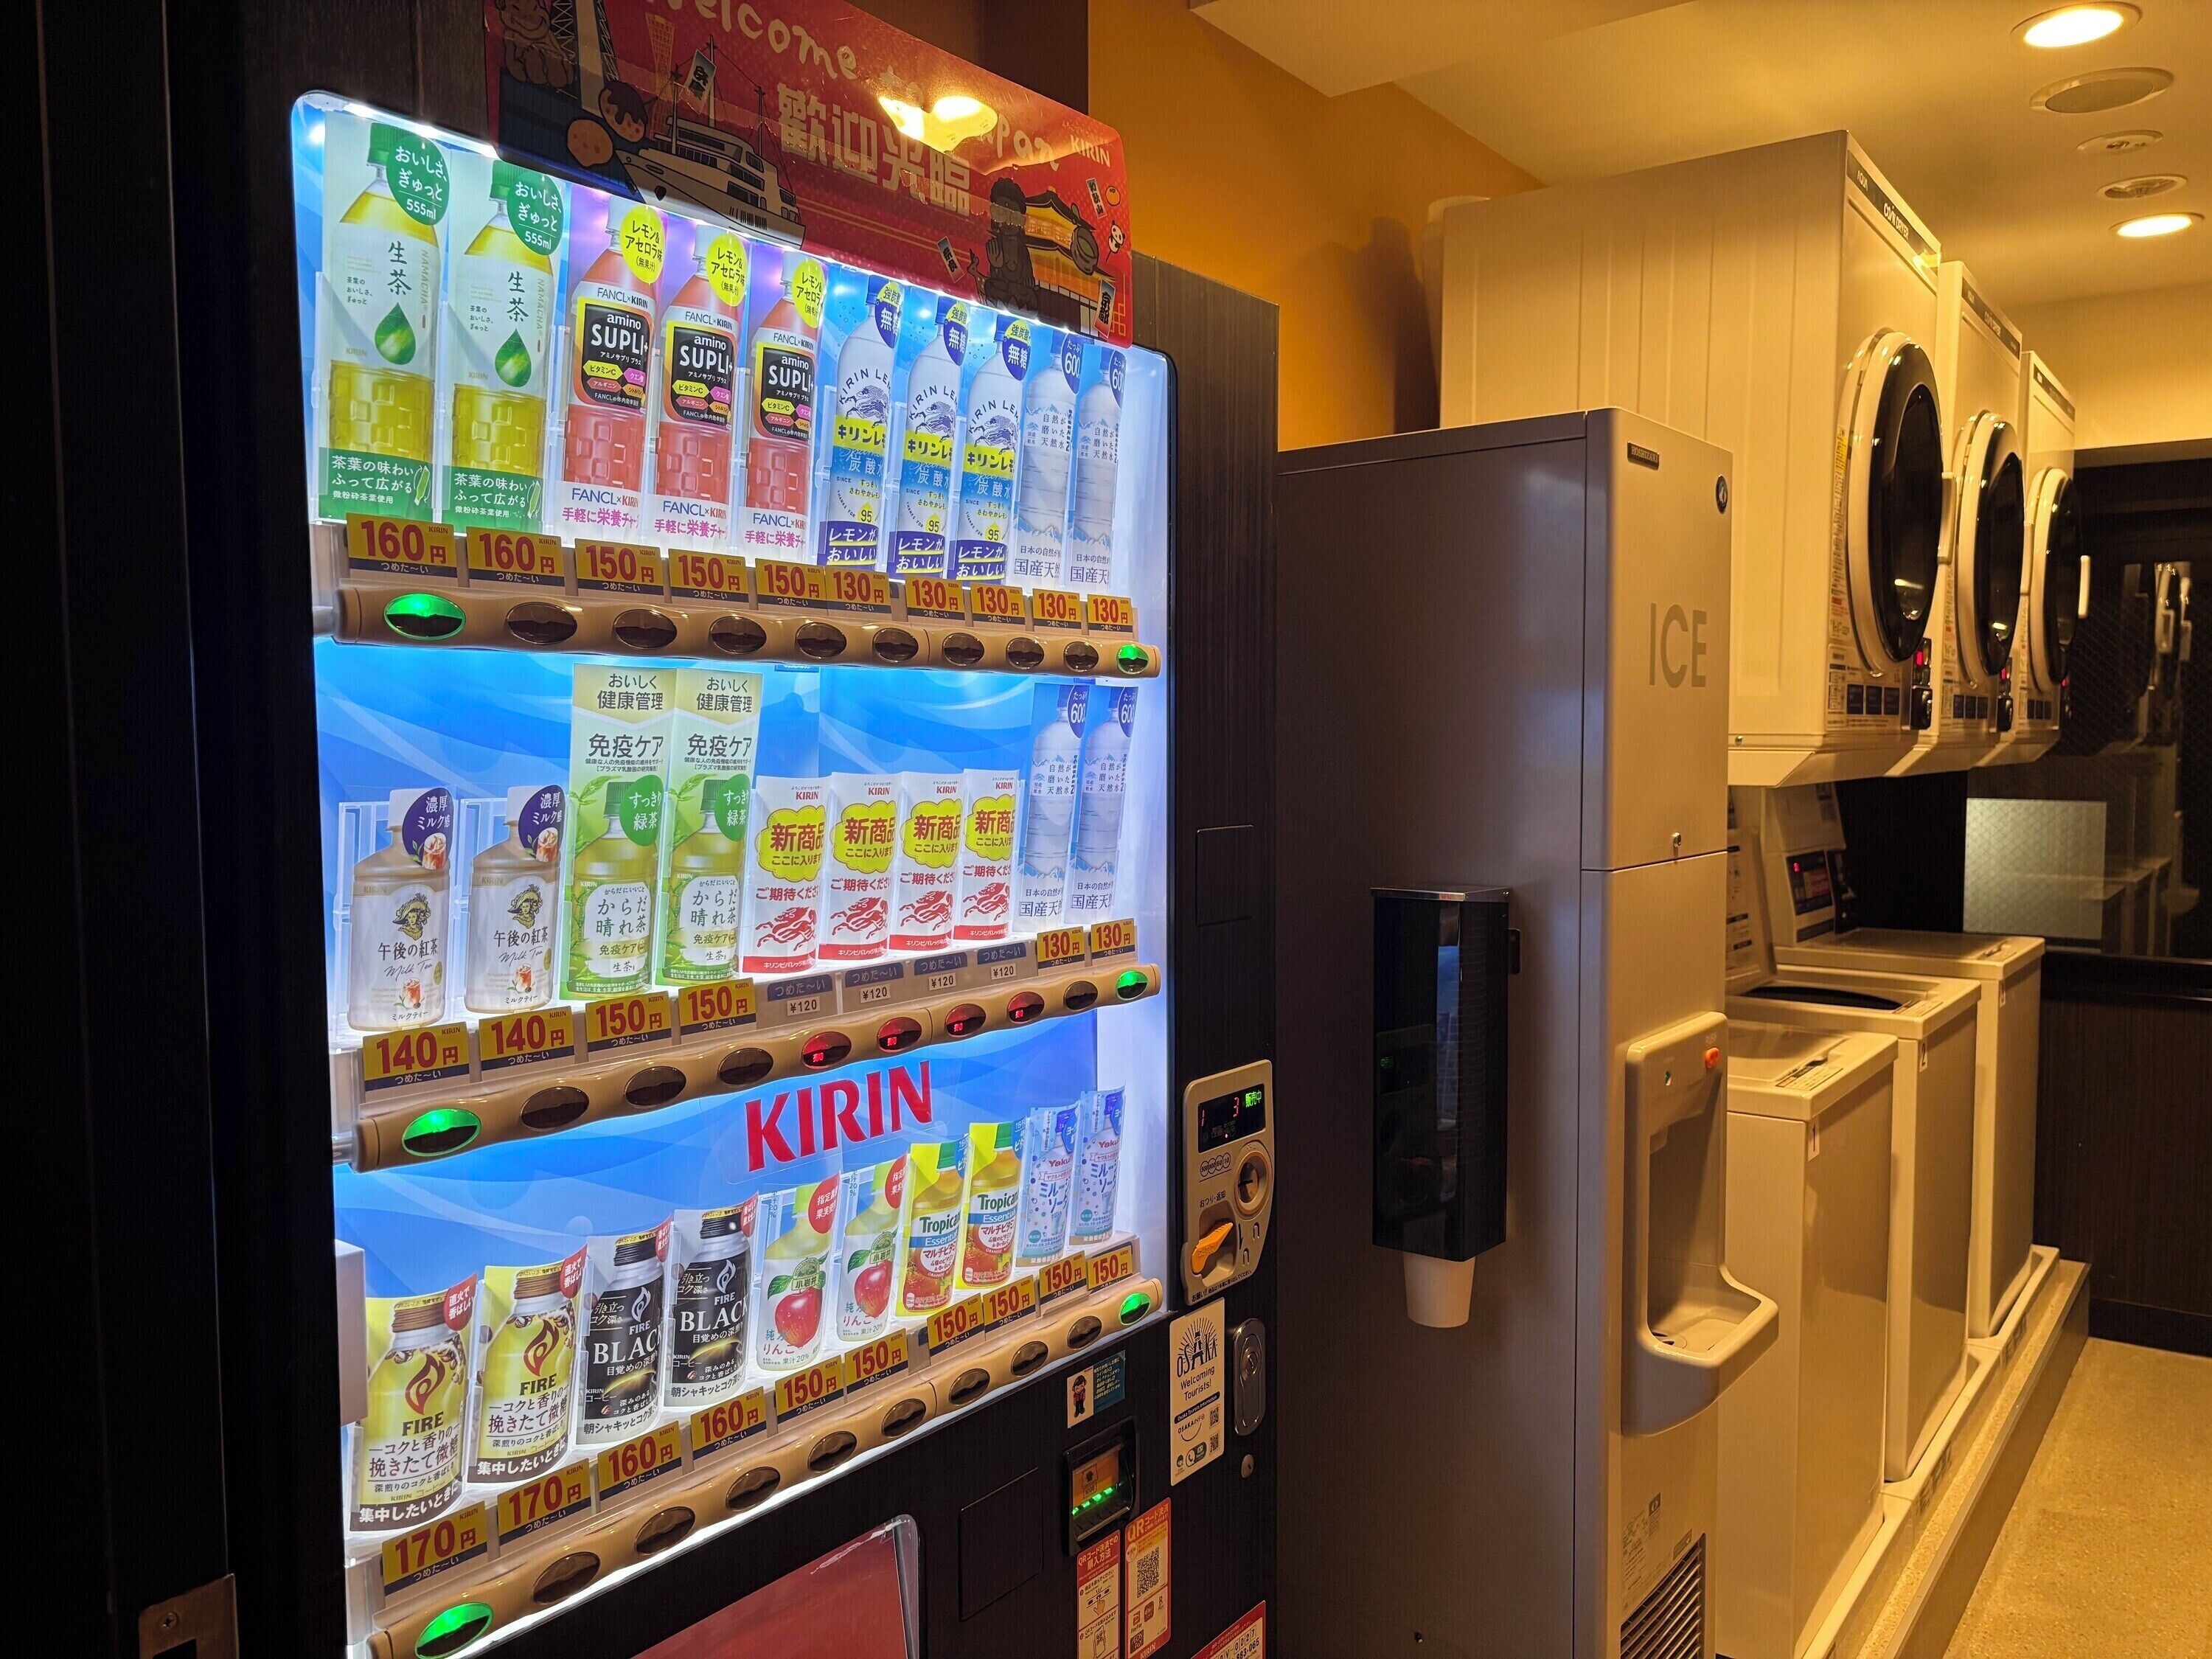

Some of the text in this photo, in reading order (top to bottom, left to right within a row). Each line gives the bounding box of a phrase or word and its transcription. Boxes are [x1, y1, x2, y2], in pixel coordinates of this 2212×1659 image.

[1071, 135, 1111, 168] KIRIN
[399, 168, 442, 201] ぎゅっと
[406, 199, 436, 220] 555ml
[518, 205, 557, 232] ぎゅっと
[525, 231, 552, 250] 555ml
[387, 240, 412, 296] 生茶
[507, 271, 529, 322] 生茶
[607, 313, 641, 331] amino
[694, 335, 726, 351] amino
[589, 364, 616, 377] ビタミンC
[782, 355, 809, 370] amino
[593, 380, 617, 389] アルギニン
[678, 383, 703, 394] ビタミンC
[681, 399, 704, 408] アルギニン
[767, 402, 790, 411] ビタミンC
[332, 455, 414, 476] 茶葉の味わい
[332, 473, 413, 494] ふって広がる
[454, 473, 528, 492] 茶葉の味わい
[454, 490, 526, 509] ふって広がる
[860, 509, 872, 523] 95
[428, 526, 448, 534] KIRIN
[929, 520, 940, 532] 95
[988, 529, 999, 540] 95
[1649, 602, 1708, 689] ICE
[609, 673, 658, 689] おいしく
[706, 677, 748, 692] おいしく
[597, 690, 664, 711] 健康管理
[696, 692, 752, 713] 健康管理
[588, 733, 664, 758] 免疫ケア
[687, 733, 752, 758] 免疫ケア
[796, 791, 819, 800] KIRIN
[868, 787, 890, 796] KIRIN
[936, 786, 957, 794] KIRIN
[995, 782, 1013, 790] KIRIN
[425, 795, 448, 813] 濃厚
[540, 793, 560, 809] 濃厚
[629, 791, 662, 810] すっきり
[633, 811, 658, 830] 緑茶
[727, 810, 746, 827] 緑茶
[597, 896, 647, 916] からだ
[692, 888, 737, 907] からだ
[596, 915, 647, 937] 晴れ茶
[691, 908, 736, 927] 晴れ茶
[493, 926, 549, 947] 午後の紅茶
[378, 937, 439, 961] 午後の紅茶
[498, 945, 543, 967] Milk Tea
[706, 950, 725, 961] 生茶
[384, 959, 433, 981] Milk Tea
[613, 961, 633, 973] 生茶
[993, 967, 1014, 978] ¥120
[931, 976, 954, 988] ¥120
[504, 995, 538, 1004] ミルクティー
[862, 987, 888, 1001] ¥120
[790, 999, 817, 1013] ¥120
[392, 1011, 428, 1021] ミルクティー
[442, 1026, 461, 1035] KIRIN
[745, 1060, 933, 1172] KIRIN
[796, 1276, 816, 1289] 小岩井
[714, 1293, 735, 1306] FIRE
[629, 1320, 650, 1335] FIRE
[1177, 1329, 1217, 1377] OSAKA
[519, 1373, 557, 1397] FIRE
[1180, 1366, 1215, 1390] Welcoming
[1184, 1379, 1211, 1401] Tourists!
[402, 1411, 444, 1437] FIRE
[369, 1435, 459, 1478] 挽きたて微糖
[477, 1435, 567, 1475] 集中したいときに
[359, 1482, 459, 1523] 集中したいときに
[459, 1508, 479, 1520] KIRIN
